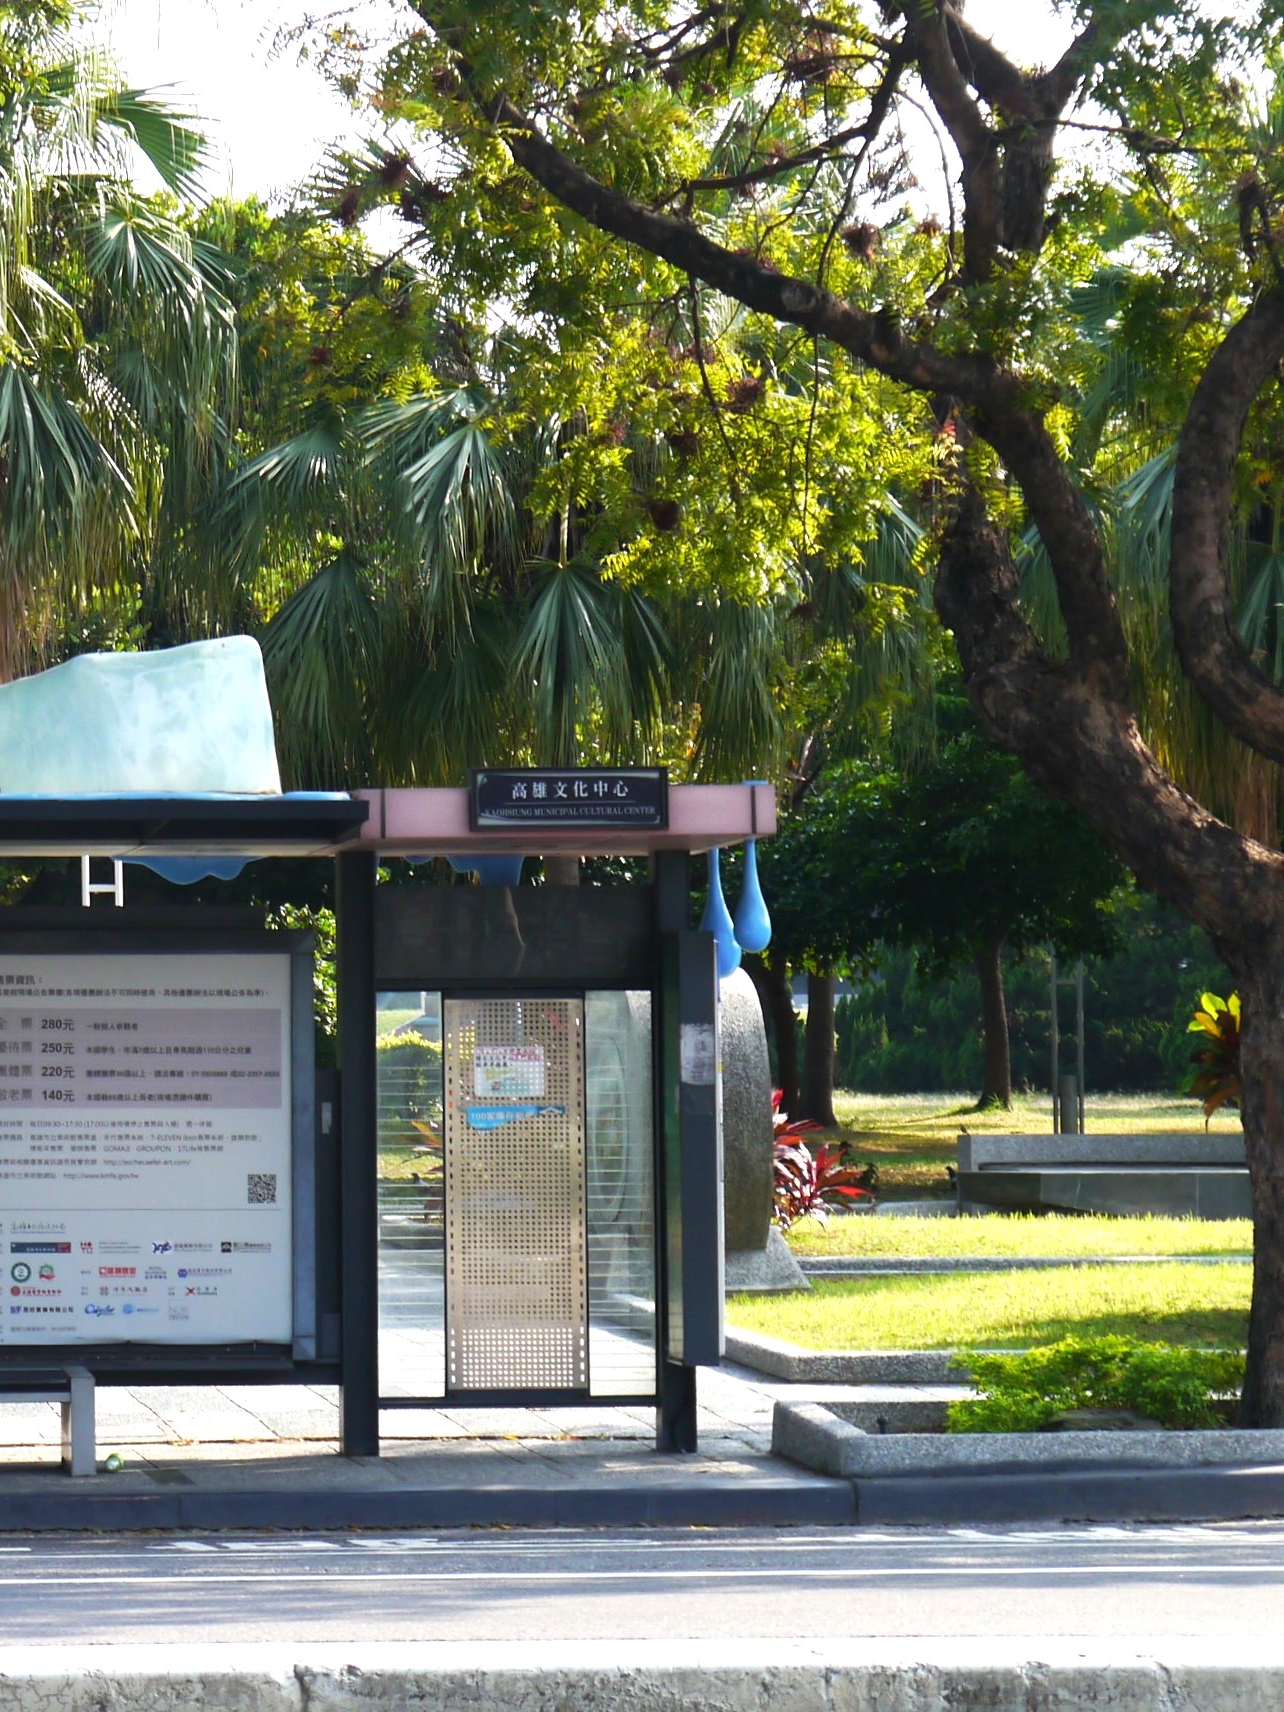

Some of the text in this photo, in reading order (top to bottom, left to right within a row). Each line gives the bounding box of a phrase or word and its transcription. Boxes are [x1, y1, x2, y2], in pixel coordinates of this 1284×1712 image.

[512, 780, 629, 800] 高雄文化中心
[484, 806, 656, 818] KAOHSIUNG MUNICIPAL CULTURAL CENTER
[41, 1018, 75, 1031] 280元
[41, 1042, 75, 1055] 250元
[41, 1066, 75, 1079] 220元
[41, 1090, 75, 1103] 140元
